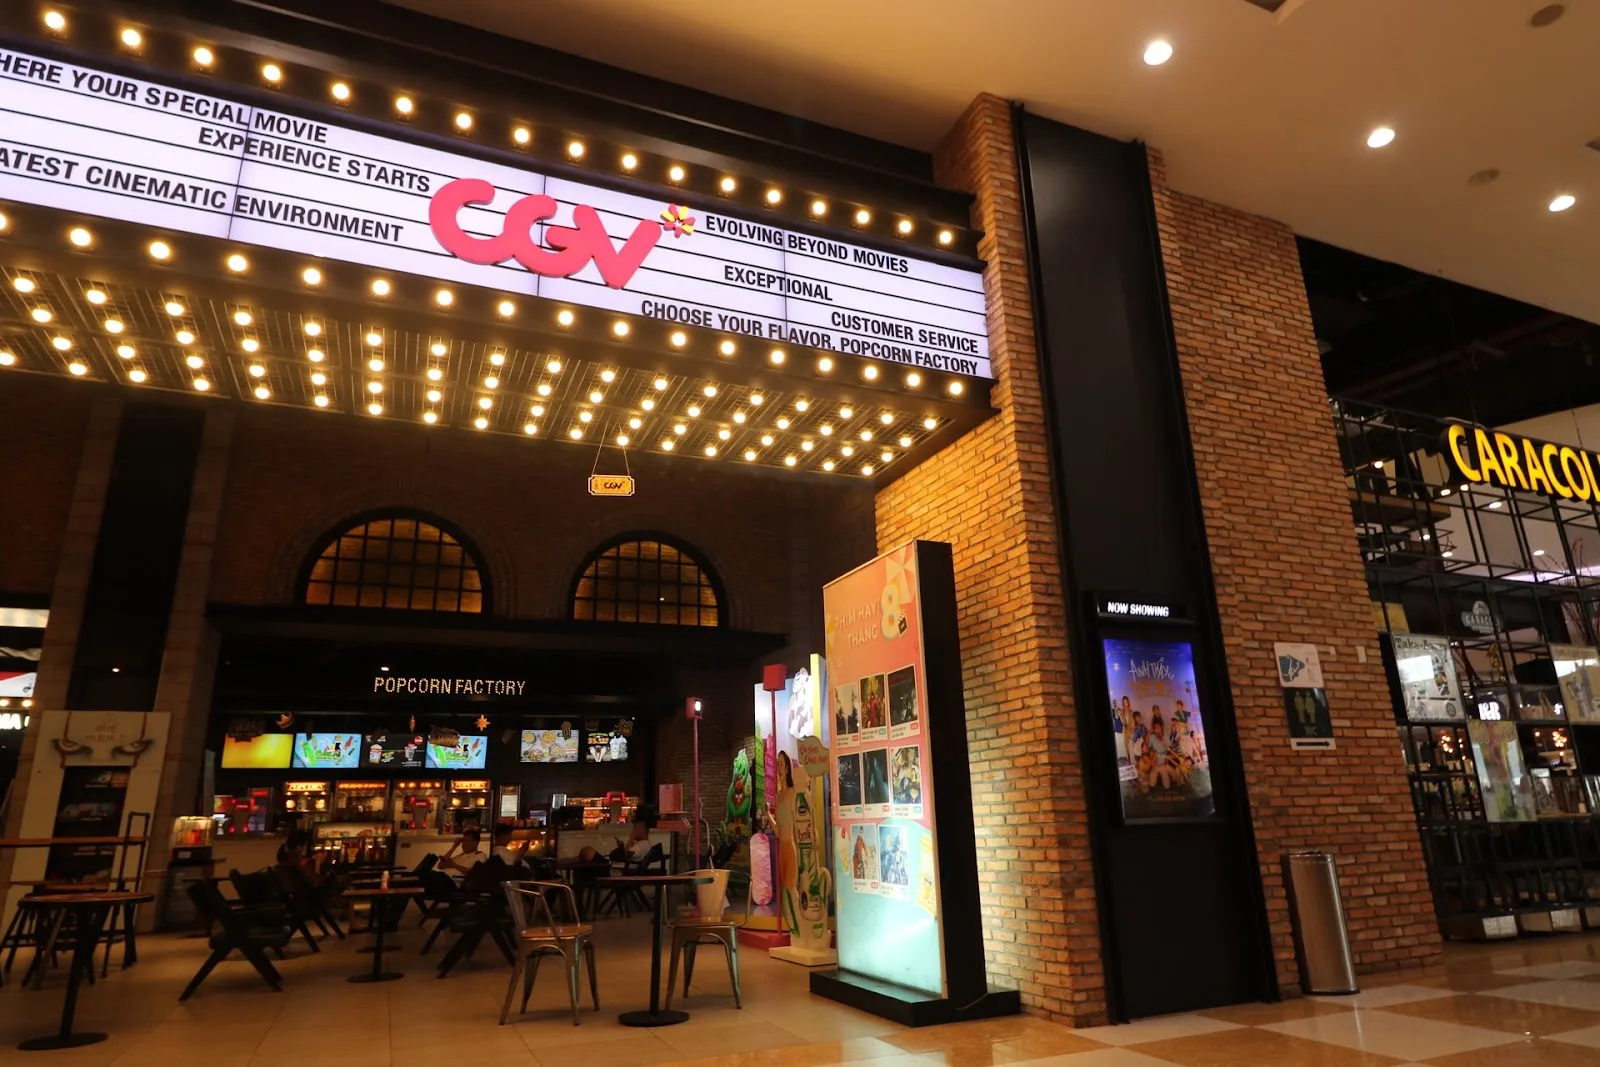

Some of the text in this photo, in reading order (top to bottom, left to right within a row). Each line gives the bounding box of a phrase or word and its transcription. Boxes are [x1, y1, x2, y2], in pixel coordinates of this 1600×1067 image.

[72, 69, 138, 102] YOUR
[144, 87, 249, 126] SPECIAL
[254, 112, 328, 143] MOVIE
[198, 127, 431, 193] EXPERIENCE STARTS
[85, 165, 227, 210] CINEMATIC
[234, 195, 404, 242] ENVIRONMENT
[428, 178, 662, 290] CGV
[705, 215, 909, 274] EVOLVING BEYOND MOVIES
[723, 265, 833, 301] EXCEPTIONAL
[641, 299, 979, 376] CHOOSE YOUR FLAVOR, POPCORN FACTORY
[831, 311, 979, 354] CUSTOMER SERVICE
[603, 481, 622, 490] CGV
[1448, 423, 1600, 503] CARACOL
[834, 599, 878, 630] PHIM HAY
[881, 583, 901, 639] 8
[1107, 601, 1170, 617] NOW SHOWING
[374, 677, 526, 695] POPCORN FACTORY
